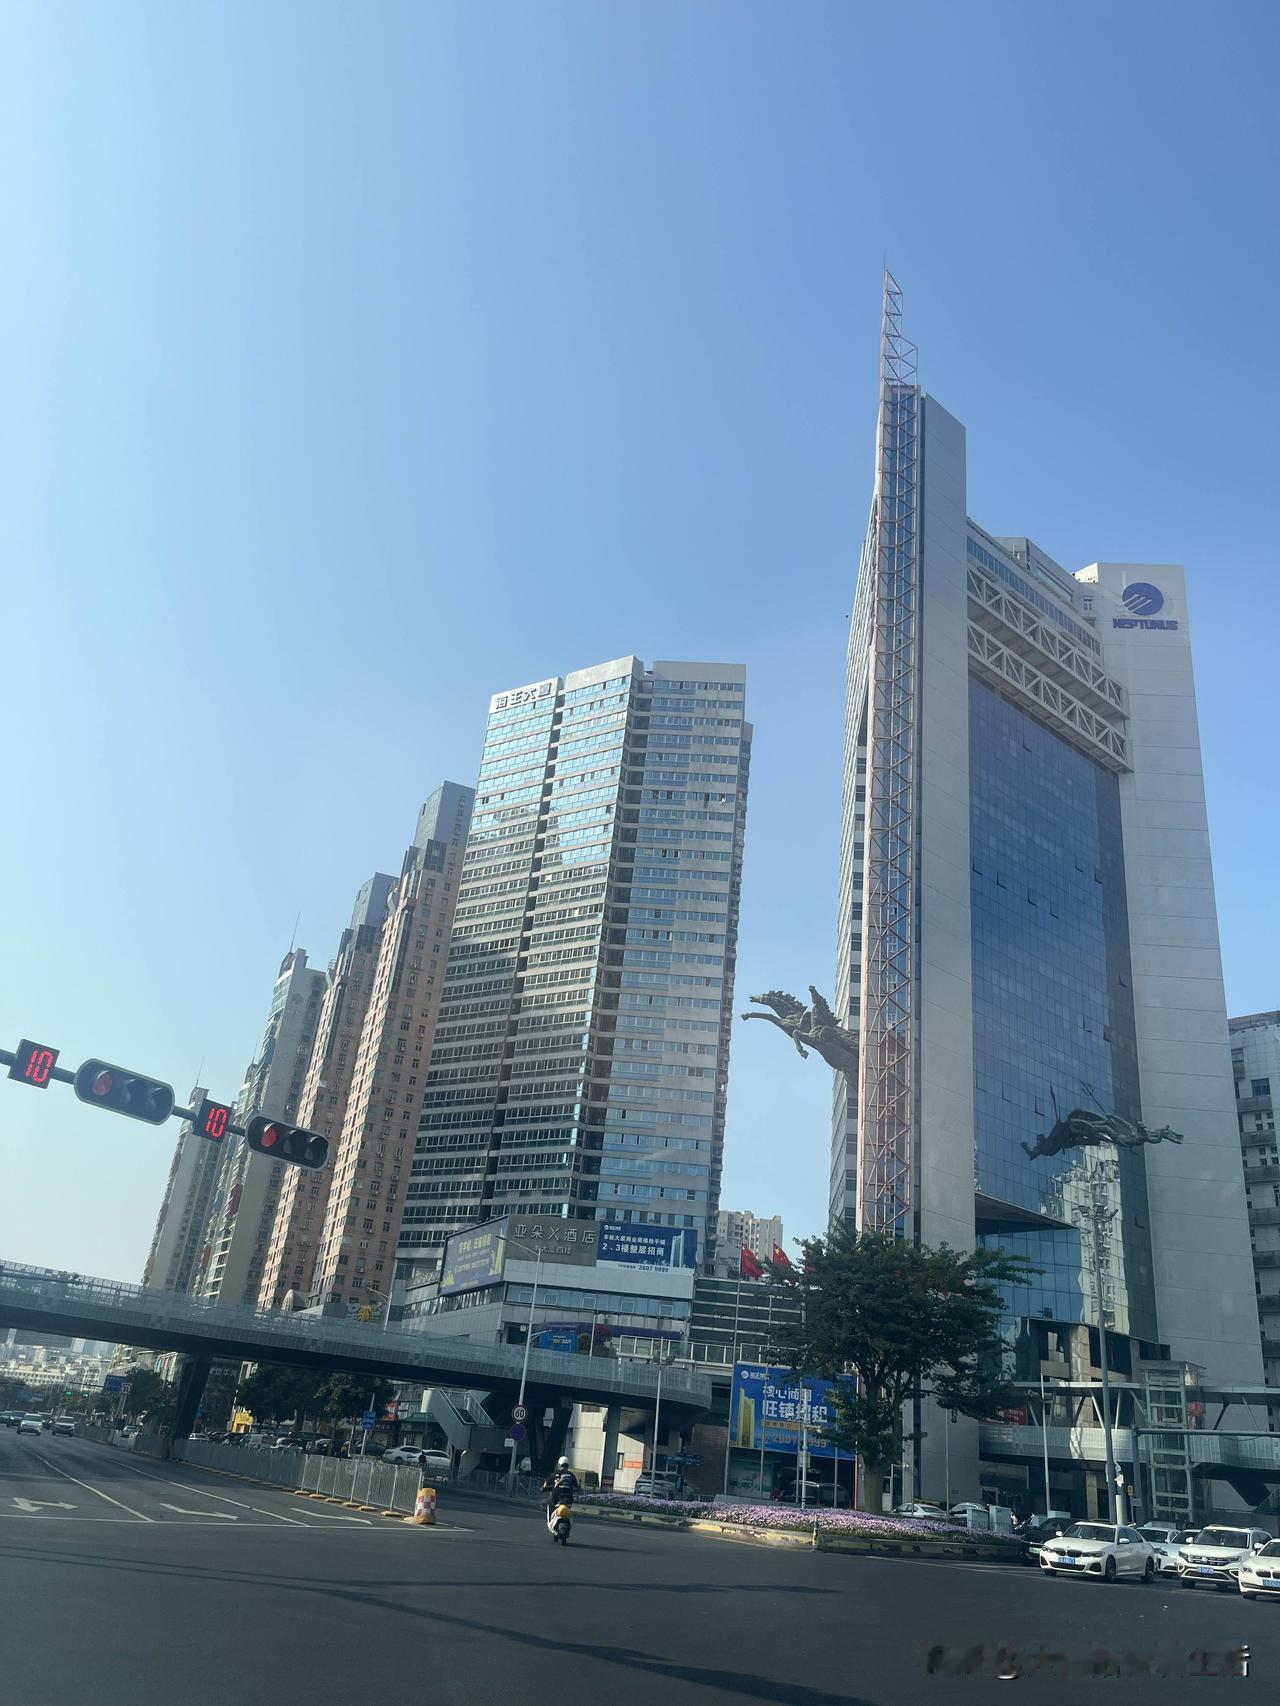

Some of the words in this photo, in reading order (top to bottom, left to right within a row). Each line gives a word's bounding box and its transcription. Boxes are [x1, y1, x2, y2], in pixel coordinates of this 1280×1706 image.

[1112, 618, 1178, 631] NEPTUNUS
[25, 1050, 54, 1083] 10
[205, 1108, 227, 1137] 10
[515, 1409, 525, 1418] 60
